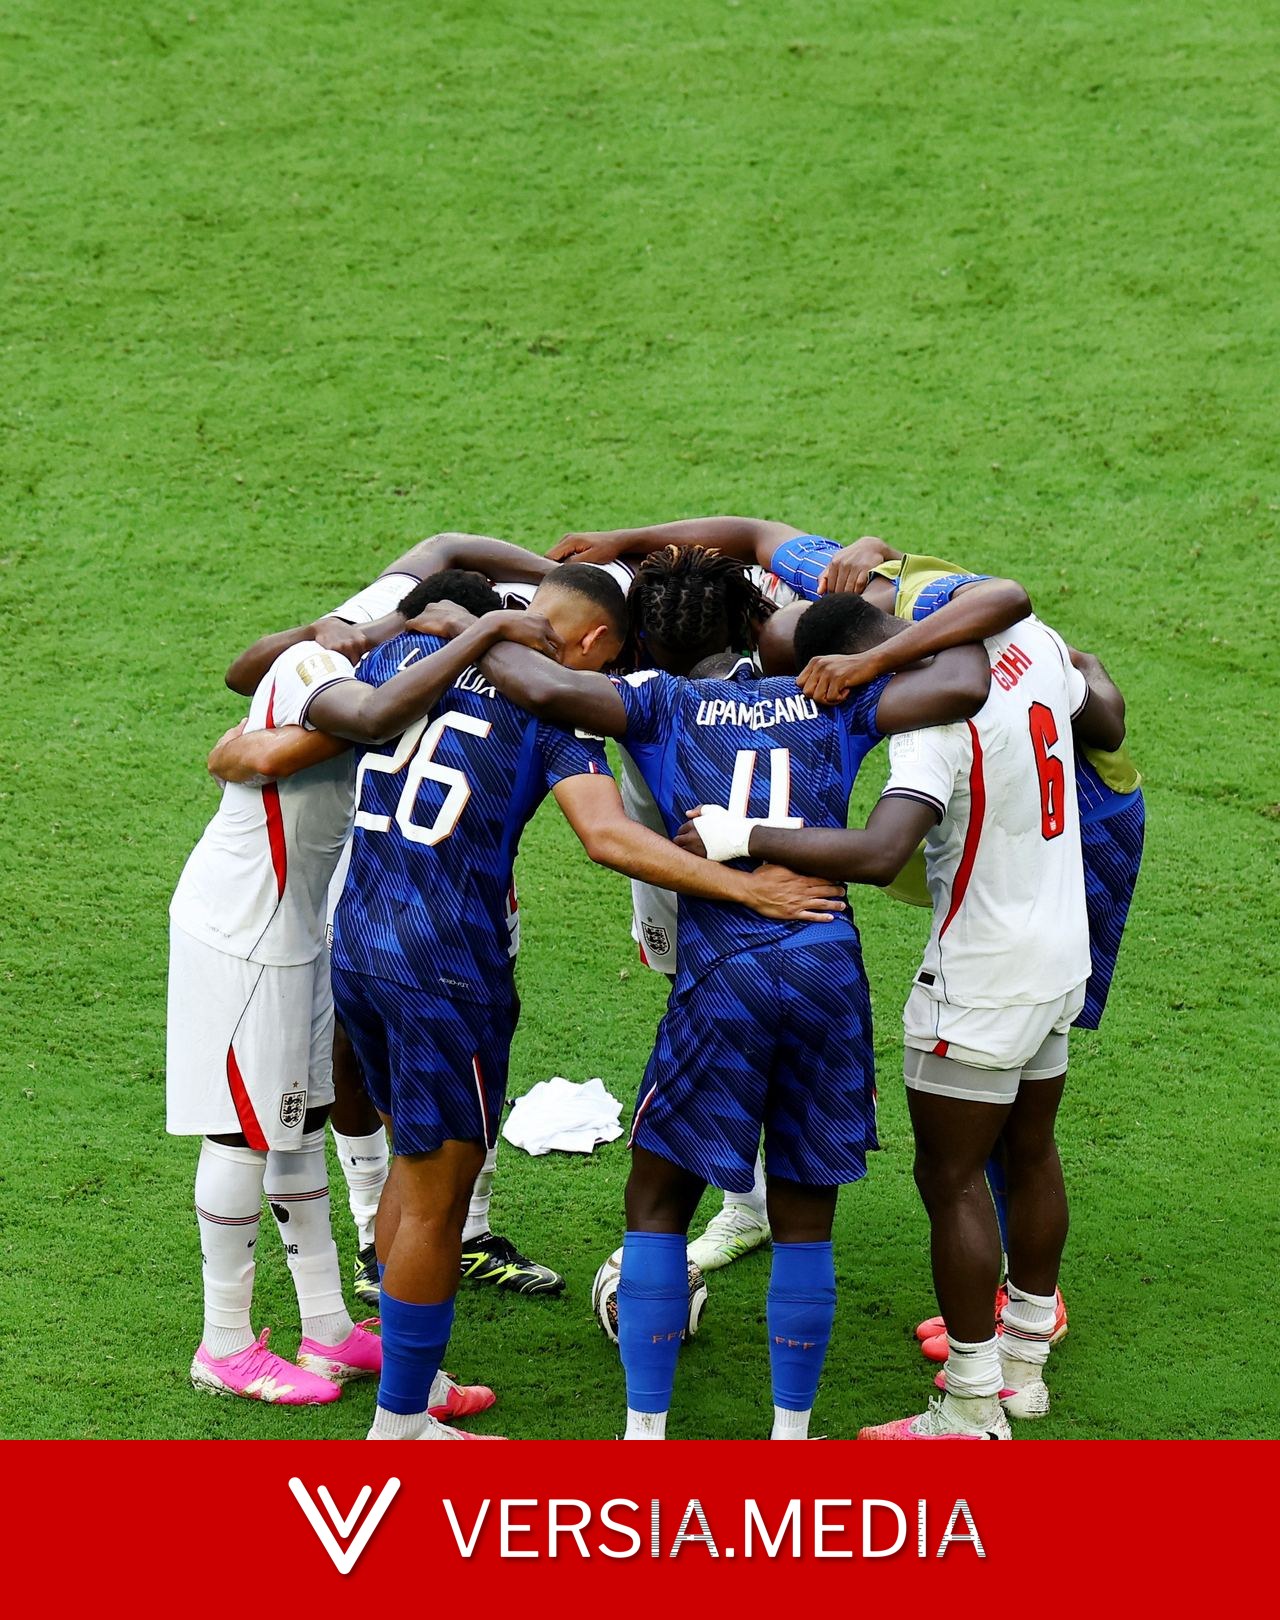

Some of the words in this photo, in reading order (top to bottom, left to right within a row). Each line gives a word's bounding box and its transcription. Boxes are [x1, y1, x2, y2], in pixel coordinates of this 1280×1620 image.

[990, 643, 1033, 692] GUHI
[354, 710, 493, 847] 26
[1028, 700, 1065, 841] 6
[775, 1335, 816, 1350] FFF
